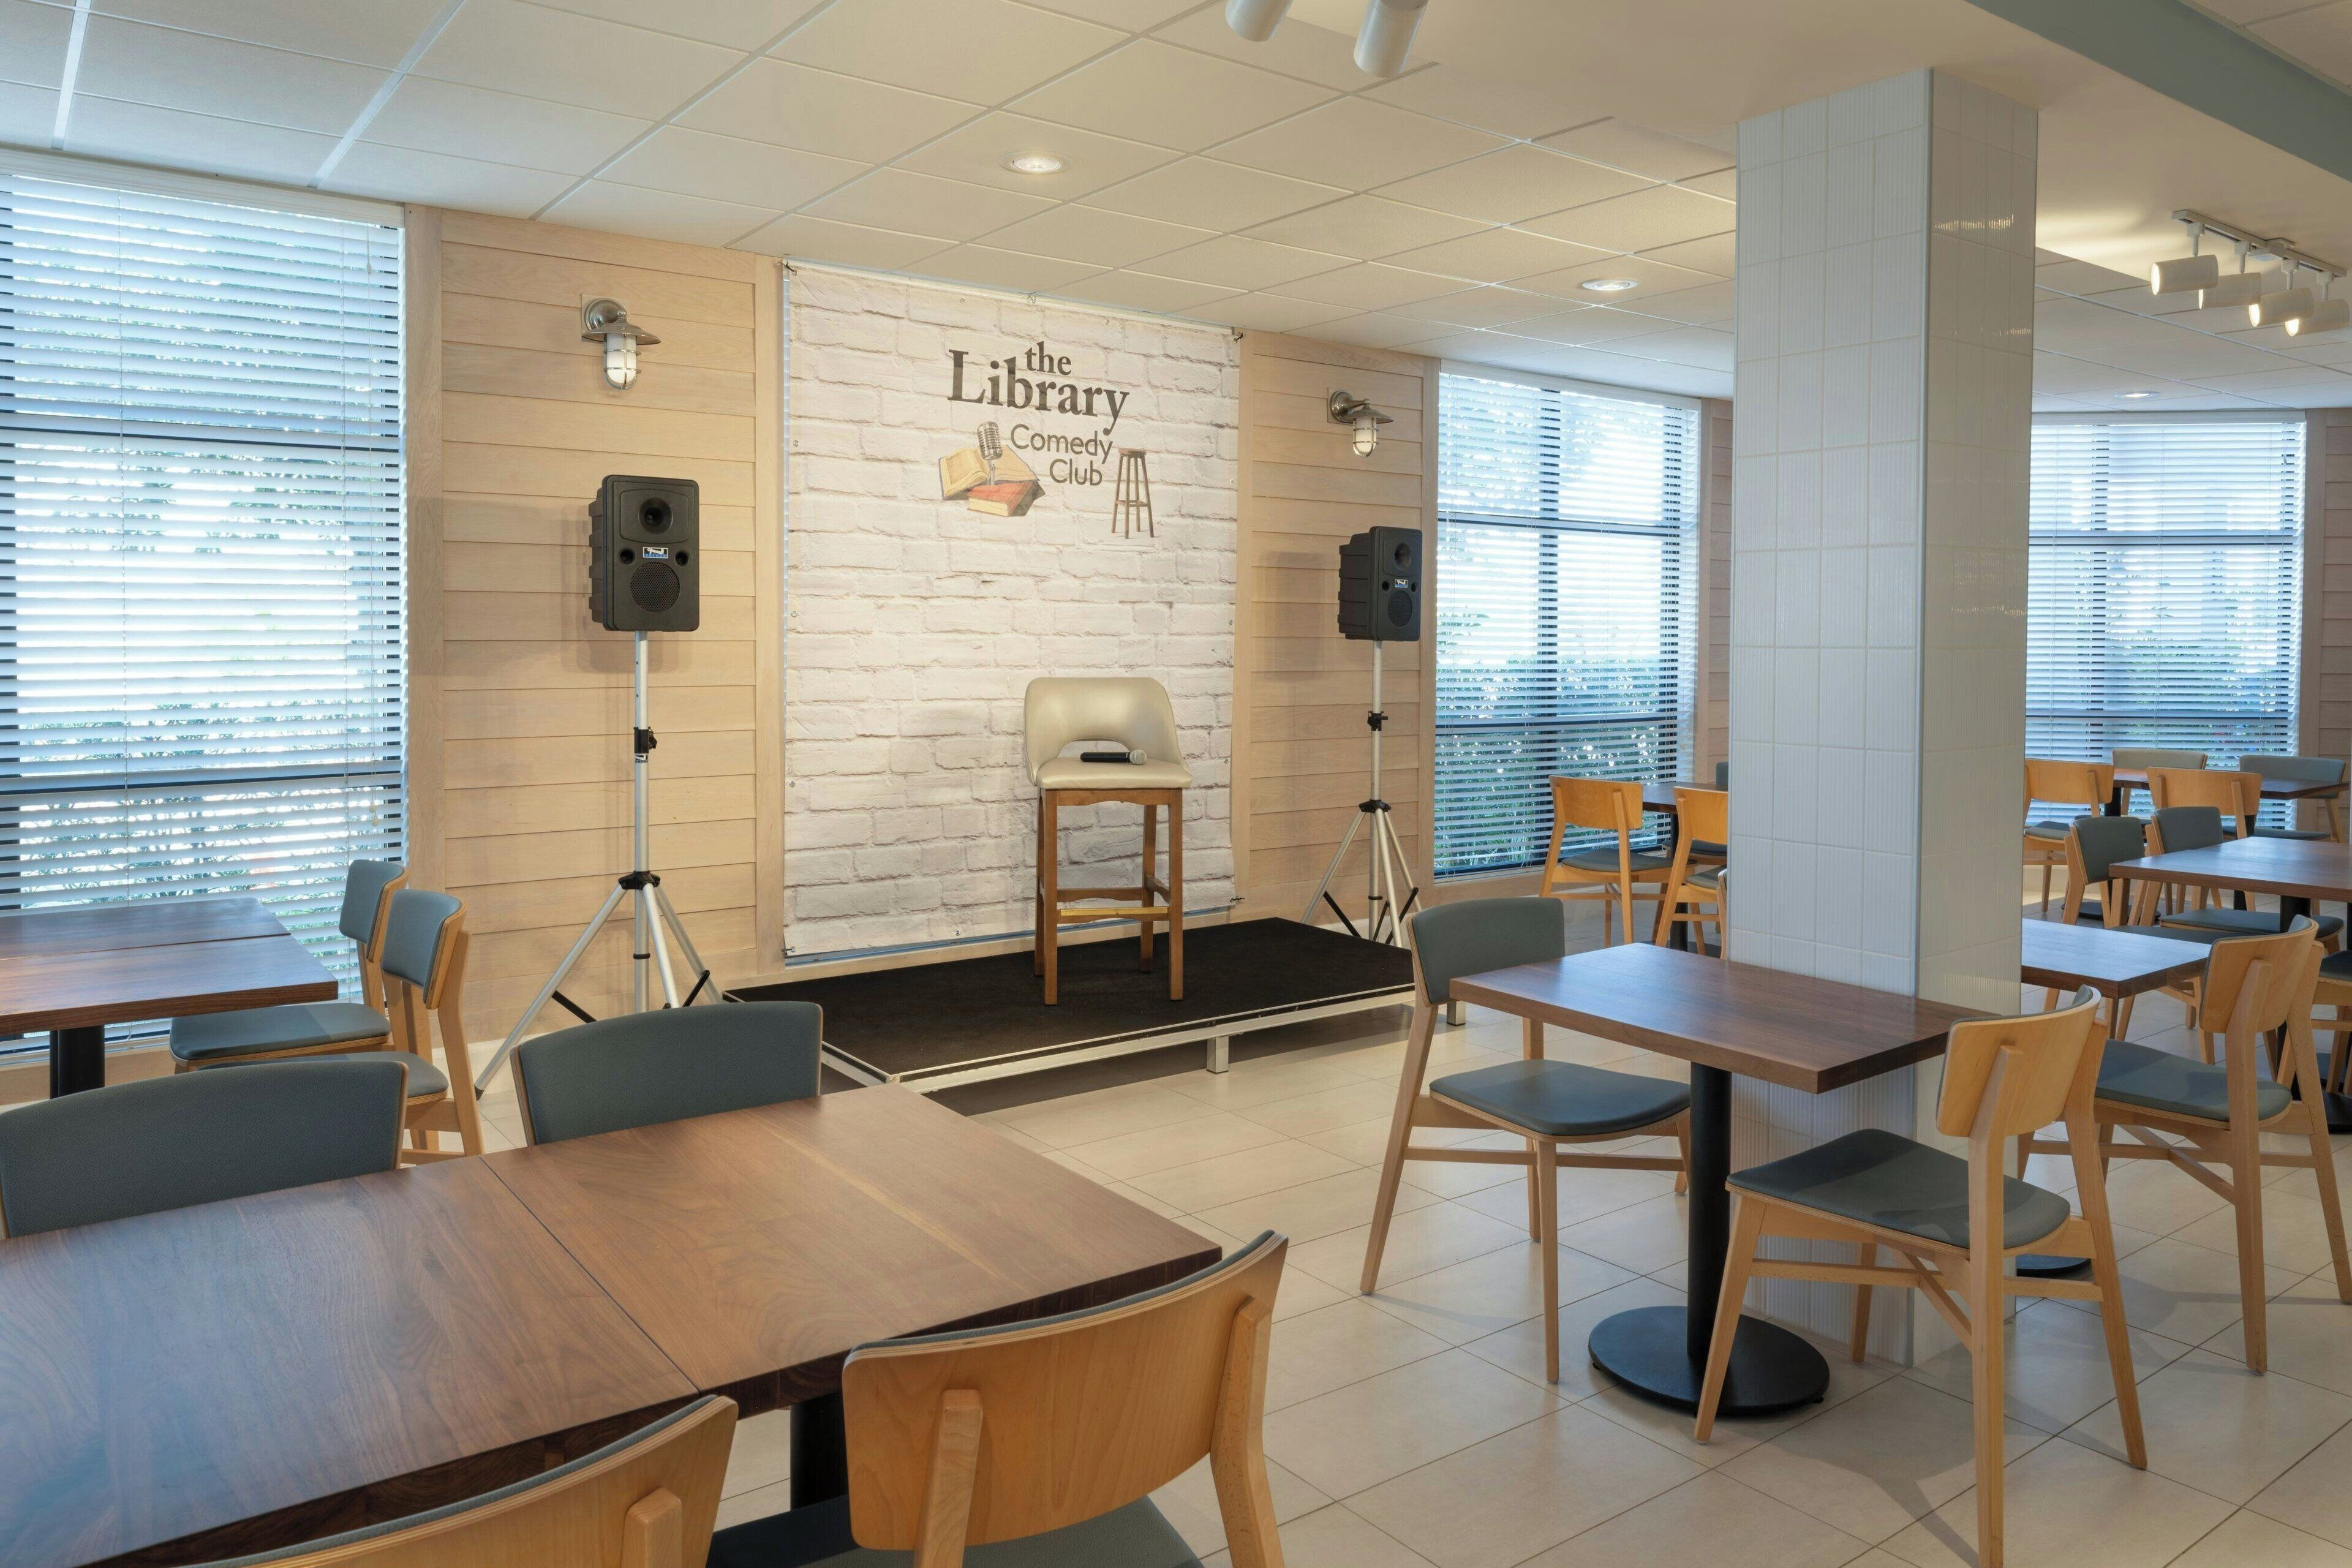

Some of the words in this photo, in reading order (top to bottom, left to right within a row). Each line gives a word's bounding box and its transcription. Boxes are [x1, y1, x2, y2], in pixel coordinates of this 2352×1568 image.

[1024, 341, 1072, 375] the
[947, 349, 1129, 435] Library
[1010, 423, 1113, 464] Comedy
[1049, 458, 1103, 486] Club
